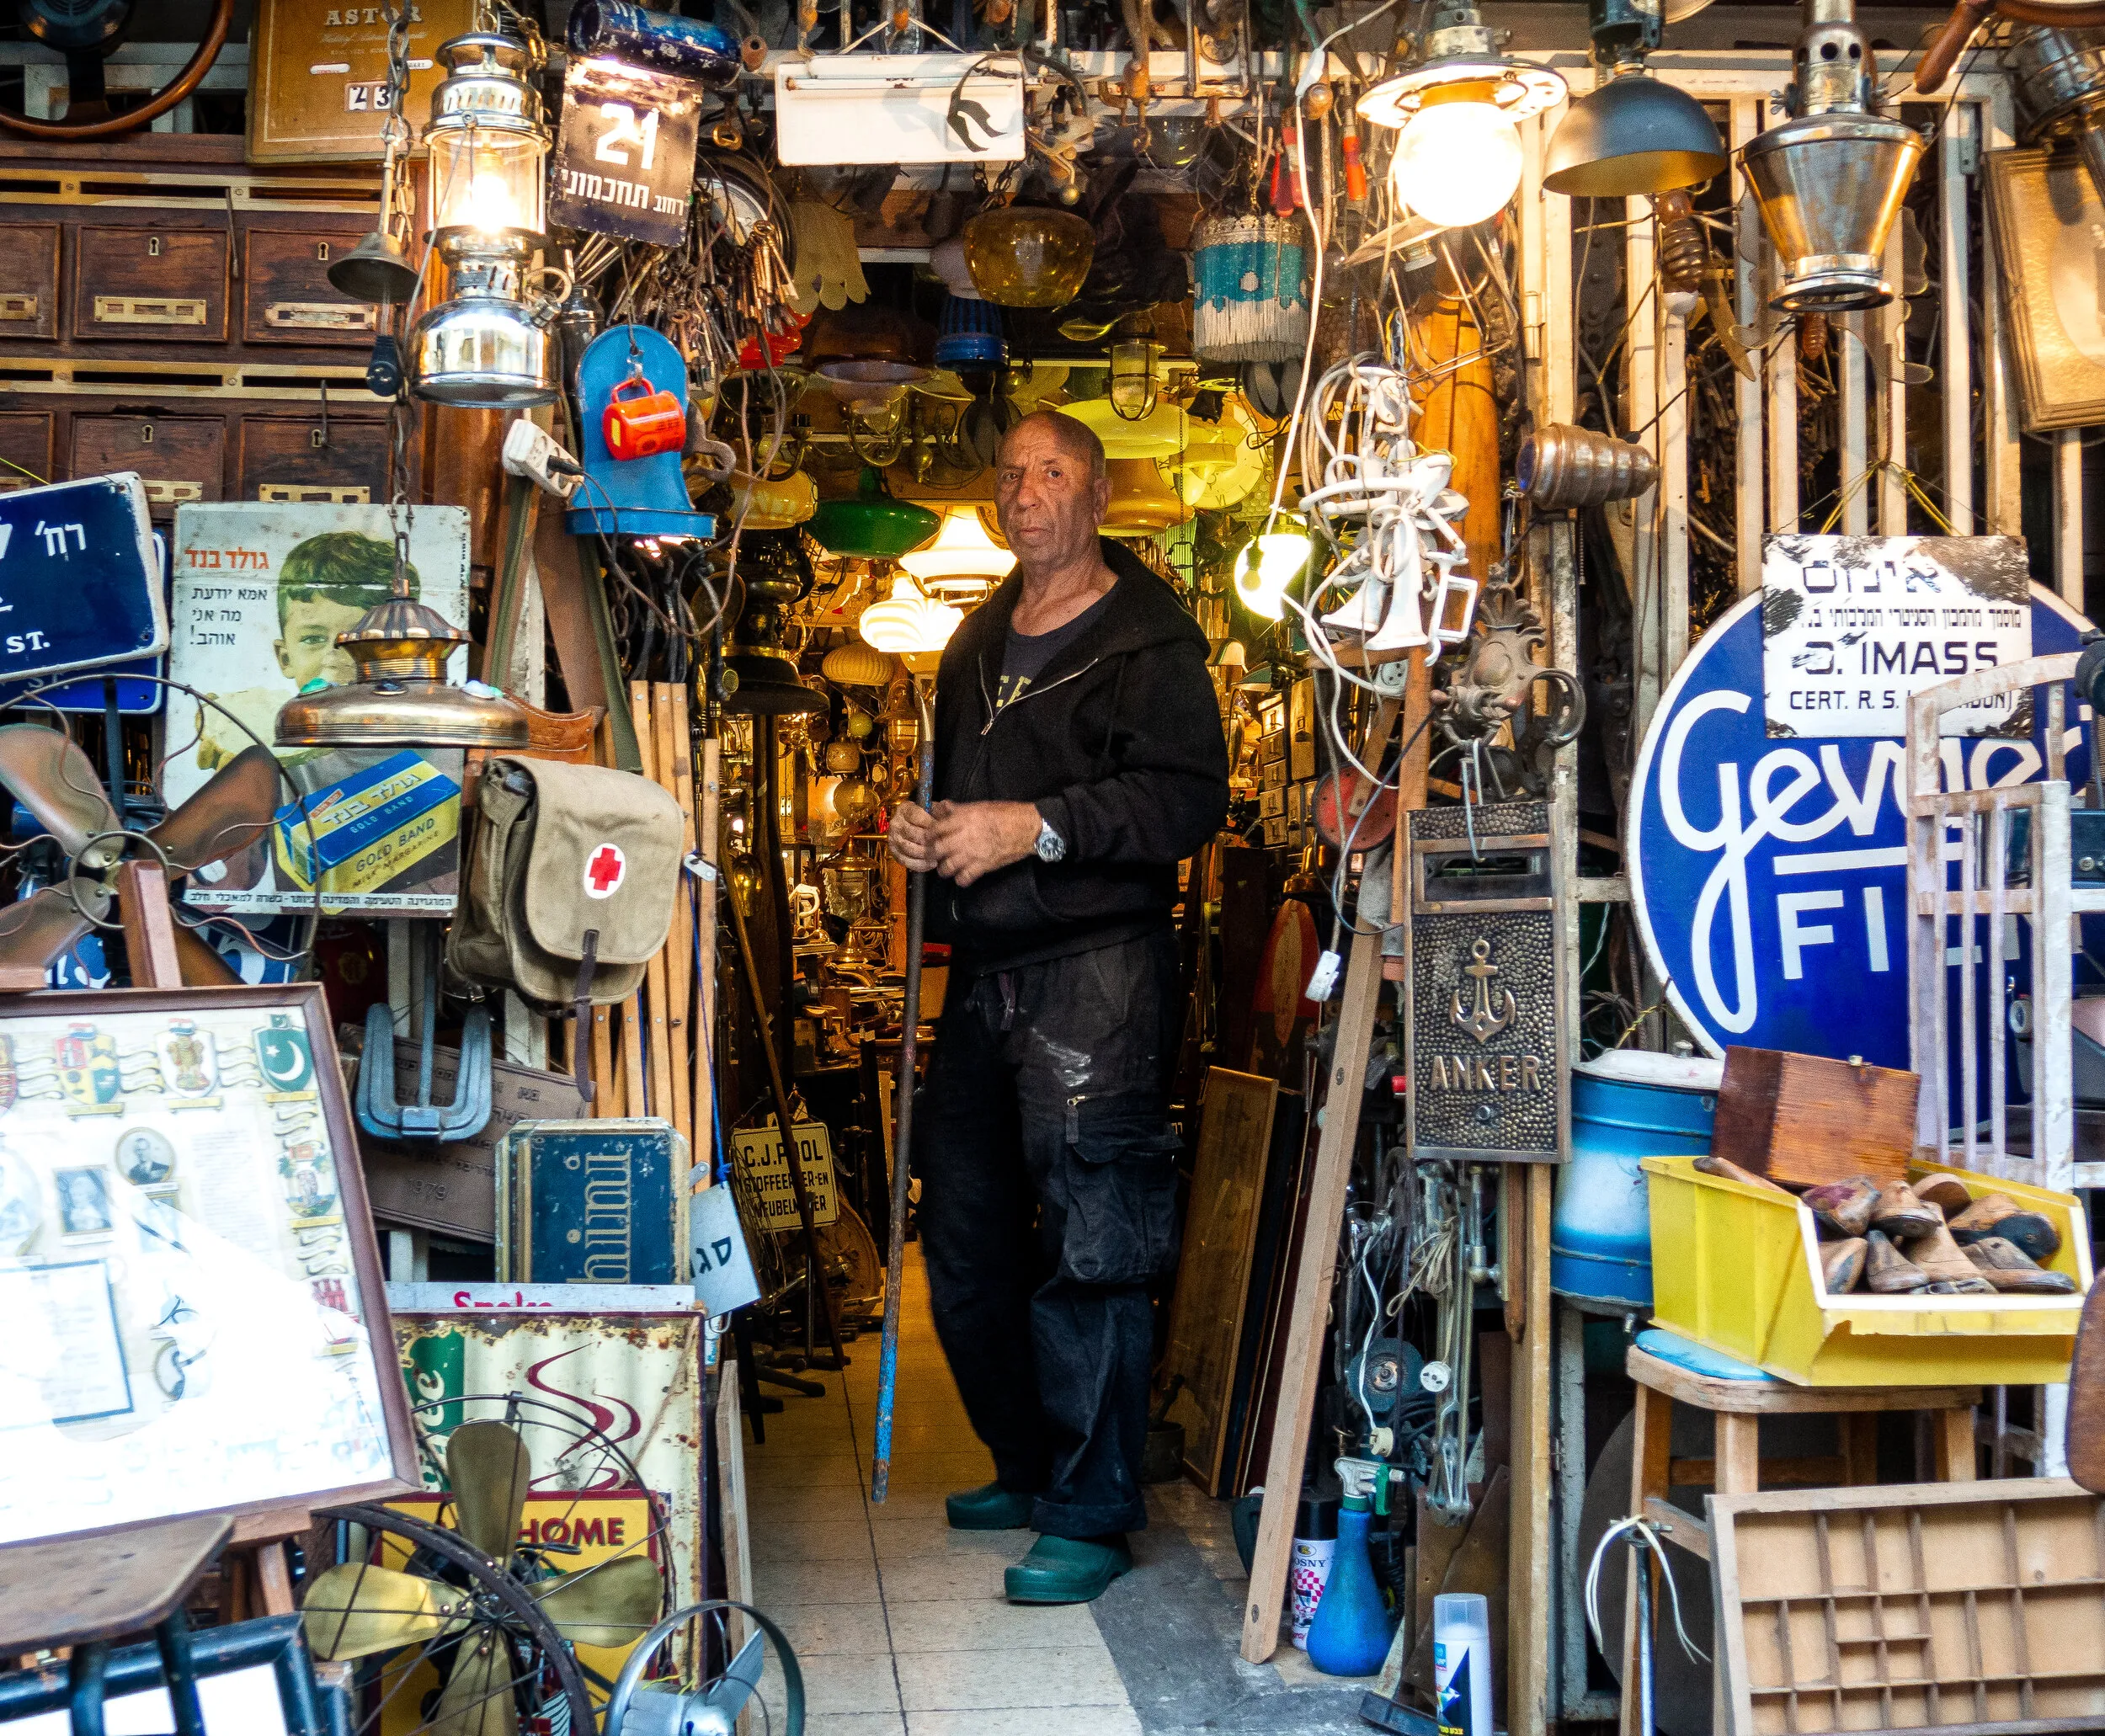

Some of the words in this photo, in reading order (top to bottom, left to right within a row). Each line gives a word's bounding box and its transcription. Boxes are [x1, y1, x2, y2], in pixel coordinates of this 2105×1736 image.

[594, 103, 660, 170] 21
[561, 168, 649, 210] תחכמוני
[653, 194, 685, 216] רחוב
[184, 549, 221, 569] בנד
[225, 546, 269, 569] גולד
[191, 588, 233, 600] יודעת
[237, 588, 268, 600] אמא
[192, 610, 215, 621] אני
[221, 610, 242, 622] מה
[6, 631, 51, 654] ST.
[190, 624, 236, 646] אוהב!
[1862, 641, 1999, 674] IMASS
[1790, 690, 1848, 710] CERT.
[1858, 690, 1875, 709] R.
[1882, 690, 1900, 709] S.
[370, 774, 422, 800] גולד
[321, 801, 371, 824] בנד
[349, 816, 379, 833] GOLD
[384, 796, 414, 814] BAND
[355, 844, 392, 872] GOLD
[398, 817, 434, 847] BAND
[1659, 689, 2092, 1034] Gevaer
[1431, 1054, 1542, 1092] ANKER
[516, 1517, 626, 1547] HOME
